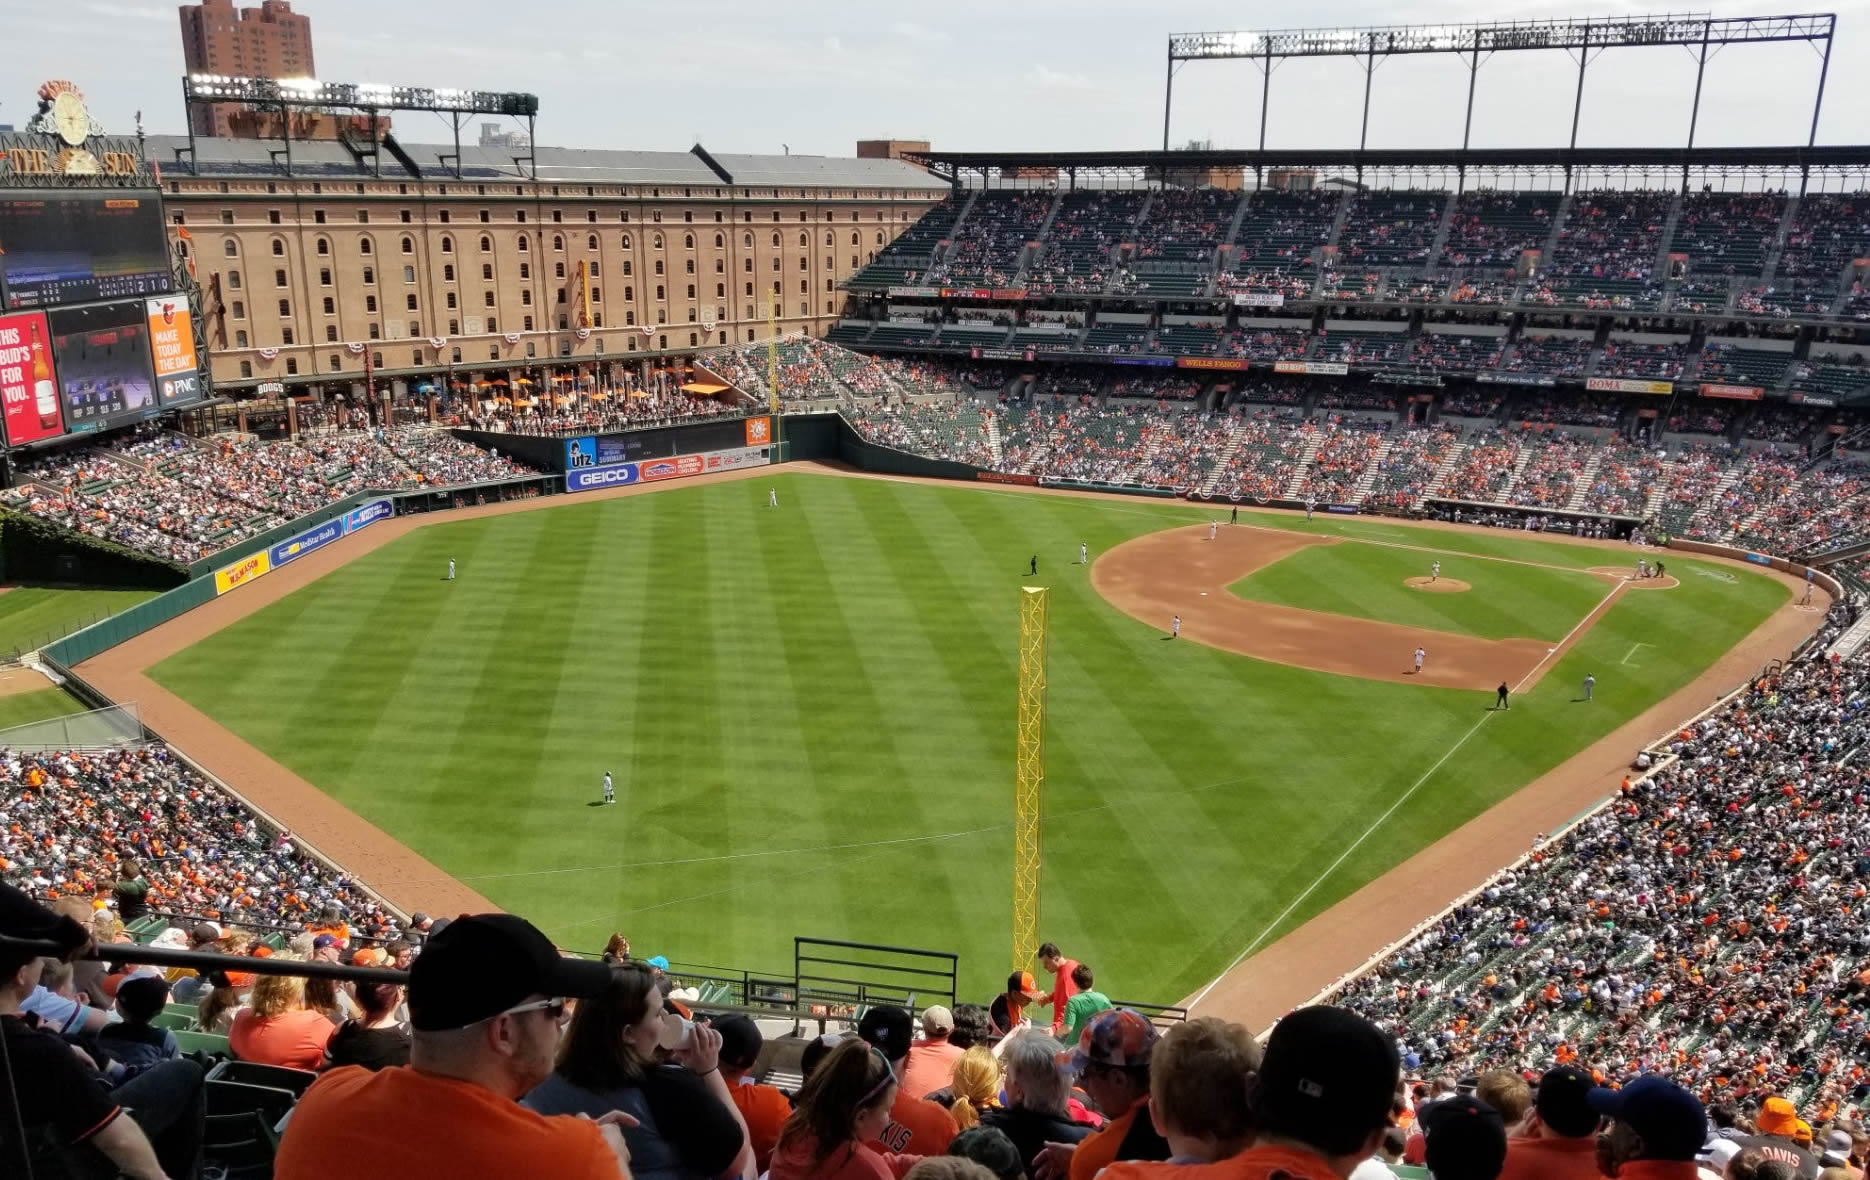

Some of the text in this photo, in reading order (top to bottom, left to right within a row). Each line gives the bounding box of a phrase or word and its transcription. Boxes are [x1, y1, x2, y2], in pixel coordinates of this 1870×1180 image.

[8, 148, 137, 175] THE SUN
[138, 281, 144, 292] 2
[151, 280, 155, 291] 1
[162, 279, 168, 290] 0
[155, 329, 179, 344] MAKE
[0, 346, 30, 365] BUD'S
[157, 342, 181, 357] TODAY
[159, 355, 191, 370] THE DAY
[1185, 359, 1241, 369] WELLS FARGO
[2, 367, 23, 384] FOR
[174, 378, 196, 393] PNC
[1589, 379, 1620, 390] ROMA
[4, 385, 30, 403] YOU.
[1803, 395, 1833, 405] Fanatics
[579, 469, 628, 486] GEICO
[300, 527, 336, 549] MedStar Health
[1762, 1146, 1800, 1168] DAVIS
